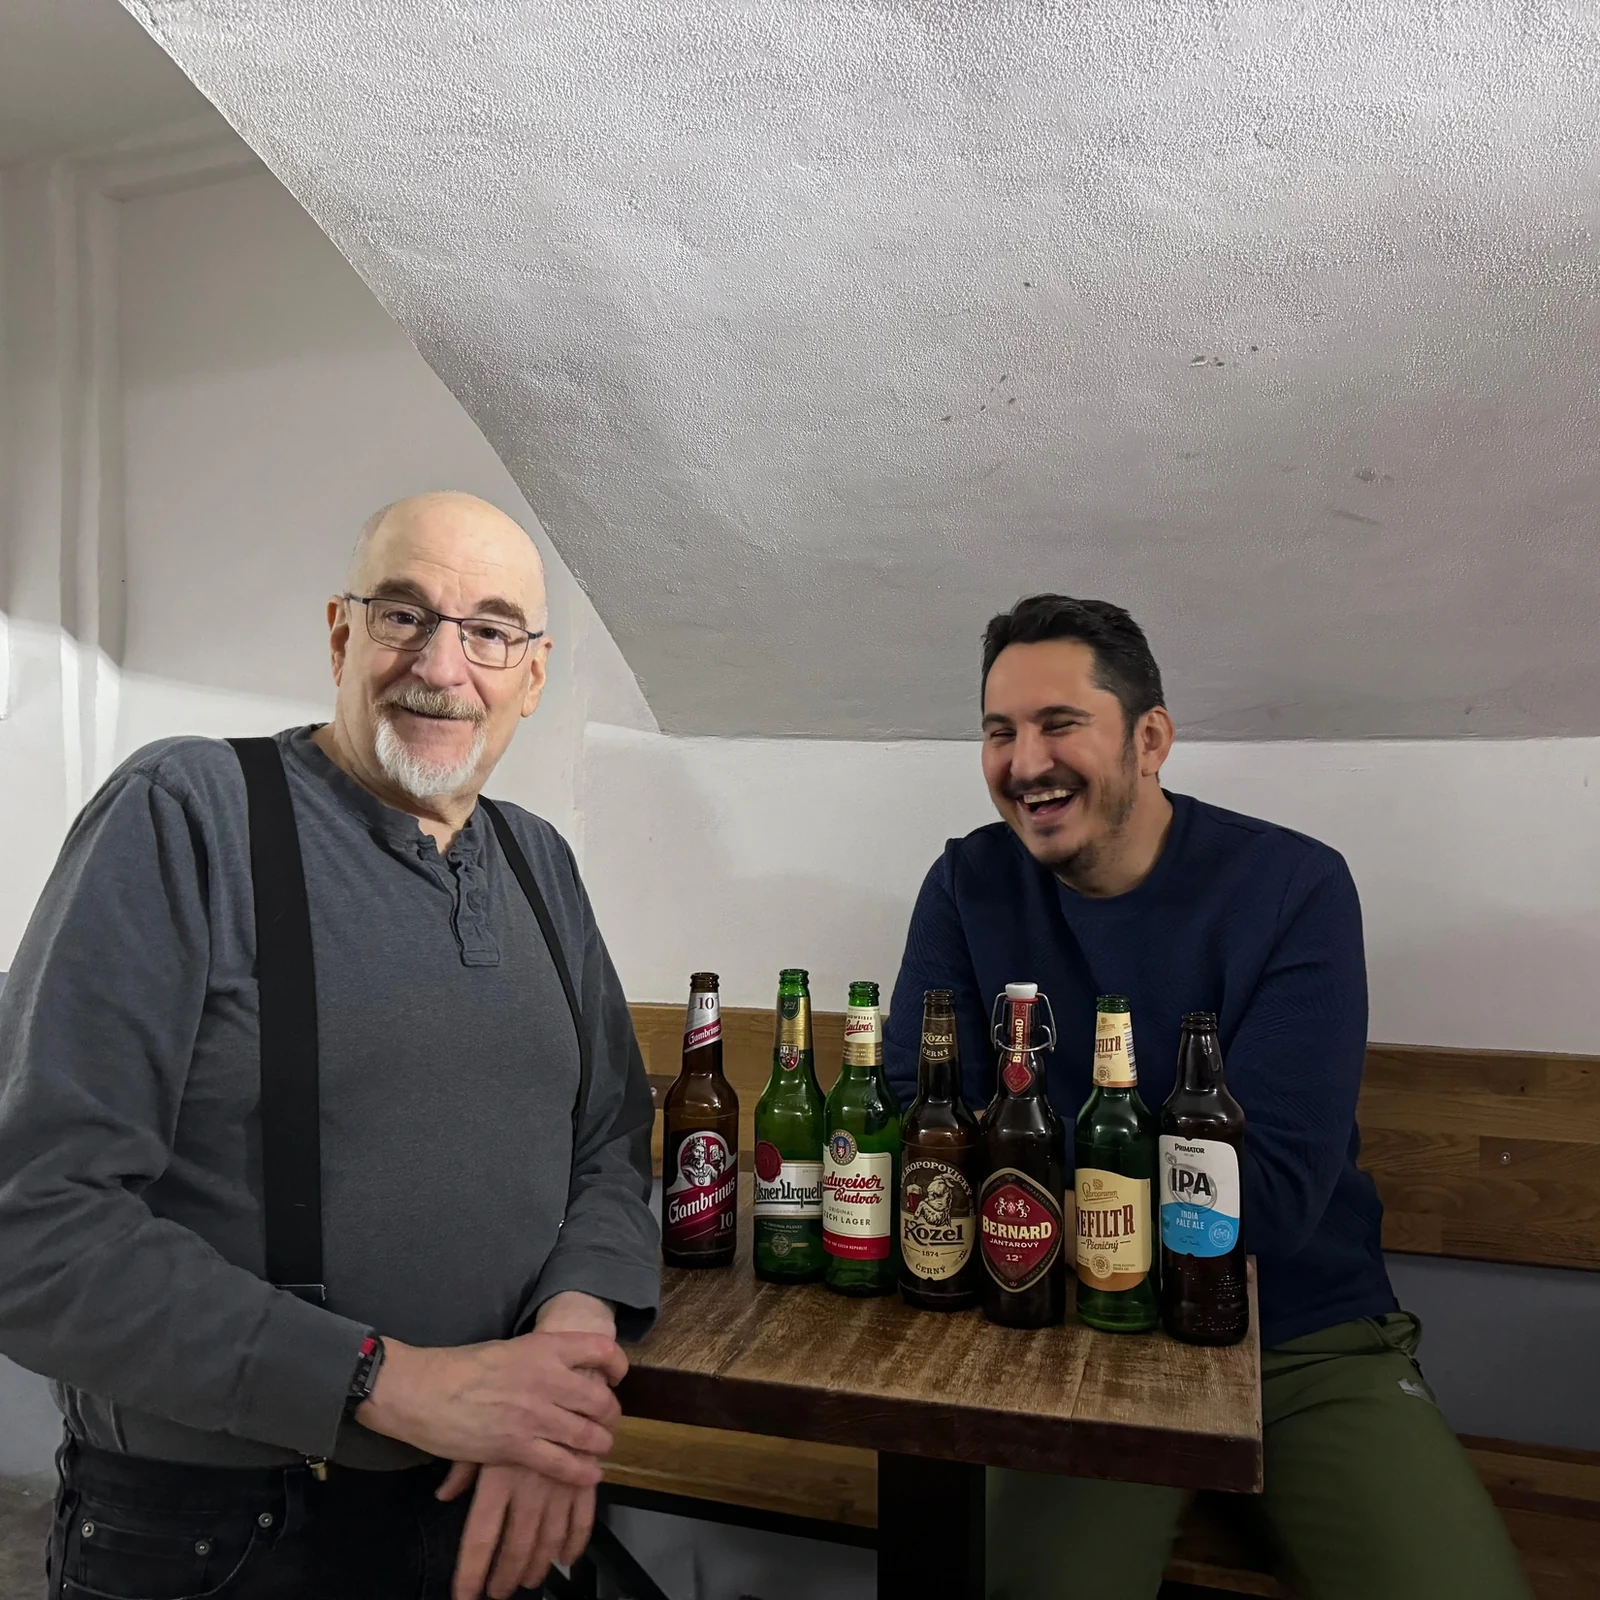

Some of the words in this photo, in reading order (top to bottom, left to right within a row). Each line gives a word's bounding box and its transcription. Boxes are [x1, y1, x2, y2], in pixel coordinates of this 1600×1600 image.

[698, 997, 715, 1010] 10
[688, 1025, 720, 1045] Gambrinus
[922, 1032, 953, 1045] Kozel
[1096, 1035, 1121, 1052] EFILTR
[822, 1171, 885, 1191] udweiser
[1171, 1168, 1212, 1196] IPA
[668, 1177, 735, 1224] Gambrinus
[755, 1180, 781, 1200] lsner
[780, 1179, 823, 1208] Urquell
[833, 1187, 883, 1205] Budvar
[823, 1210, 838, 1222] ZECH
[840, 1216, 871, 1226] LAGER
[829, 1206, 854, 1216] ORIGINAL
[1181, 1210, 1199, 1220] INDIA
[720, 1211, 734, 1230] 10
[982, 1215, 1052, 1240] BERNARD
[1176, 1218, 1190, 1229] PALE
[1192, 1220, 1205, 1230] ALE
[903, 1218, 964, 1246] Kozel
[989, 1238, 1040, 1249] JANTAROVÝ
[915, 1263, 946, 1276] ČERNÝ
